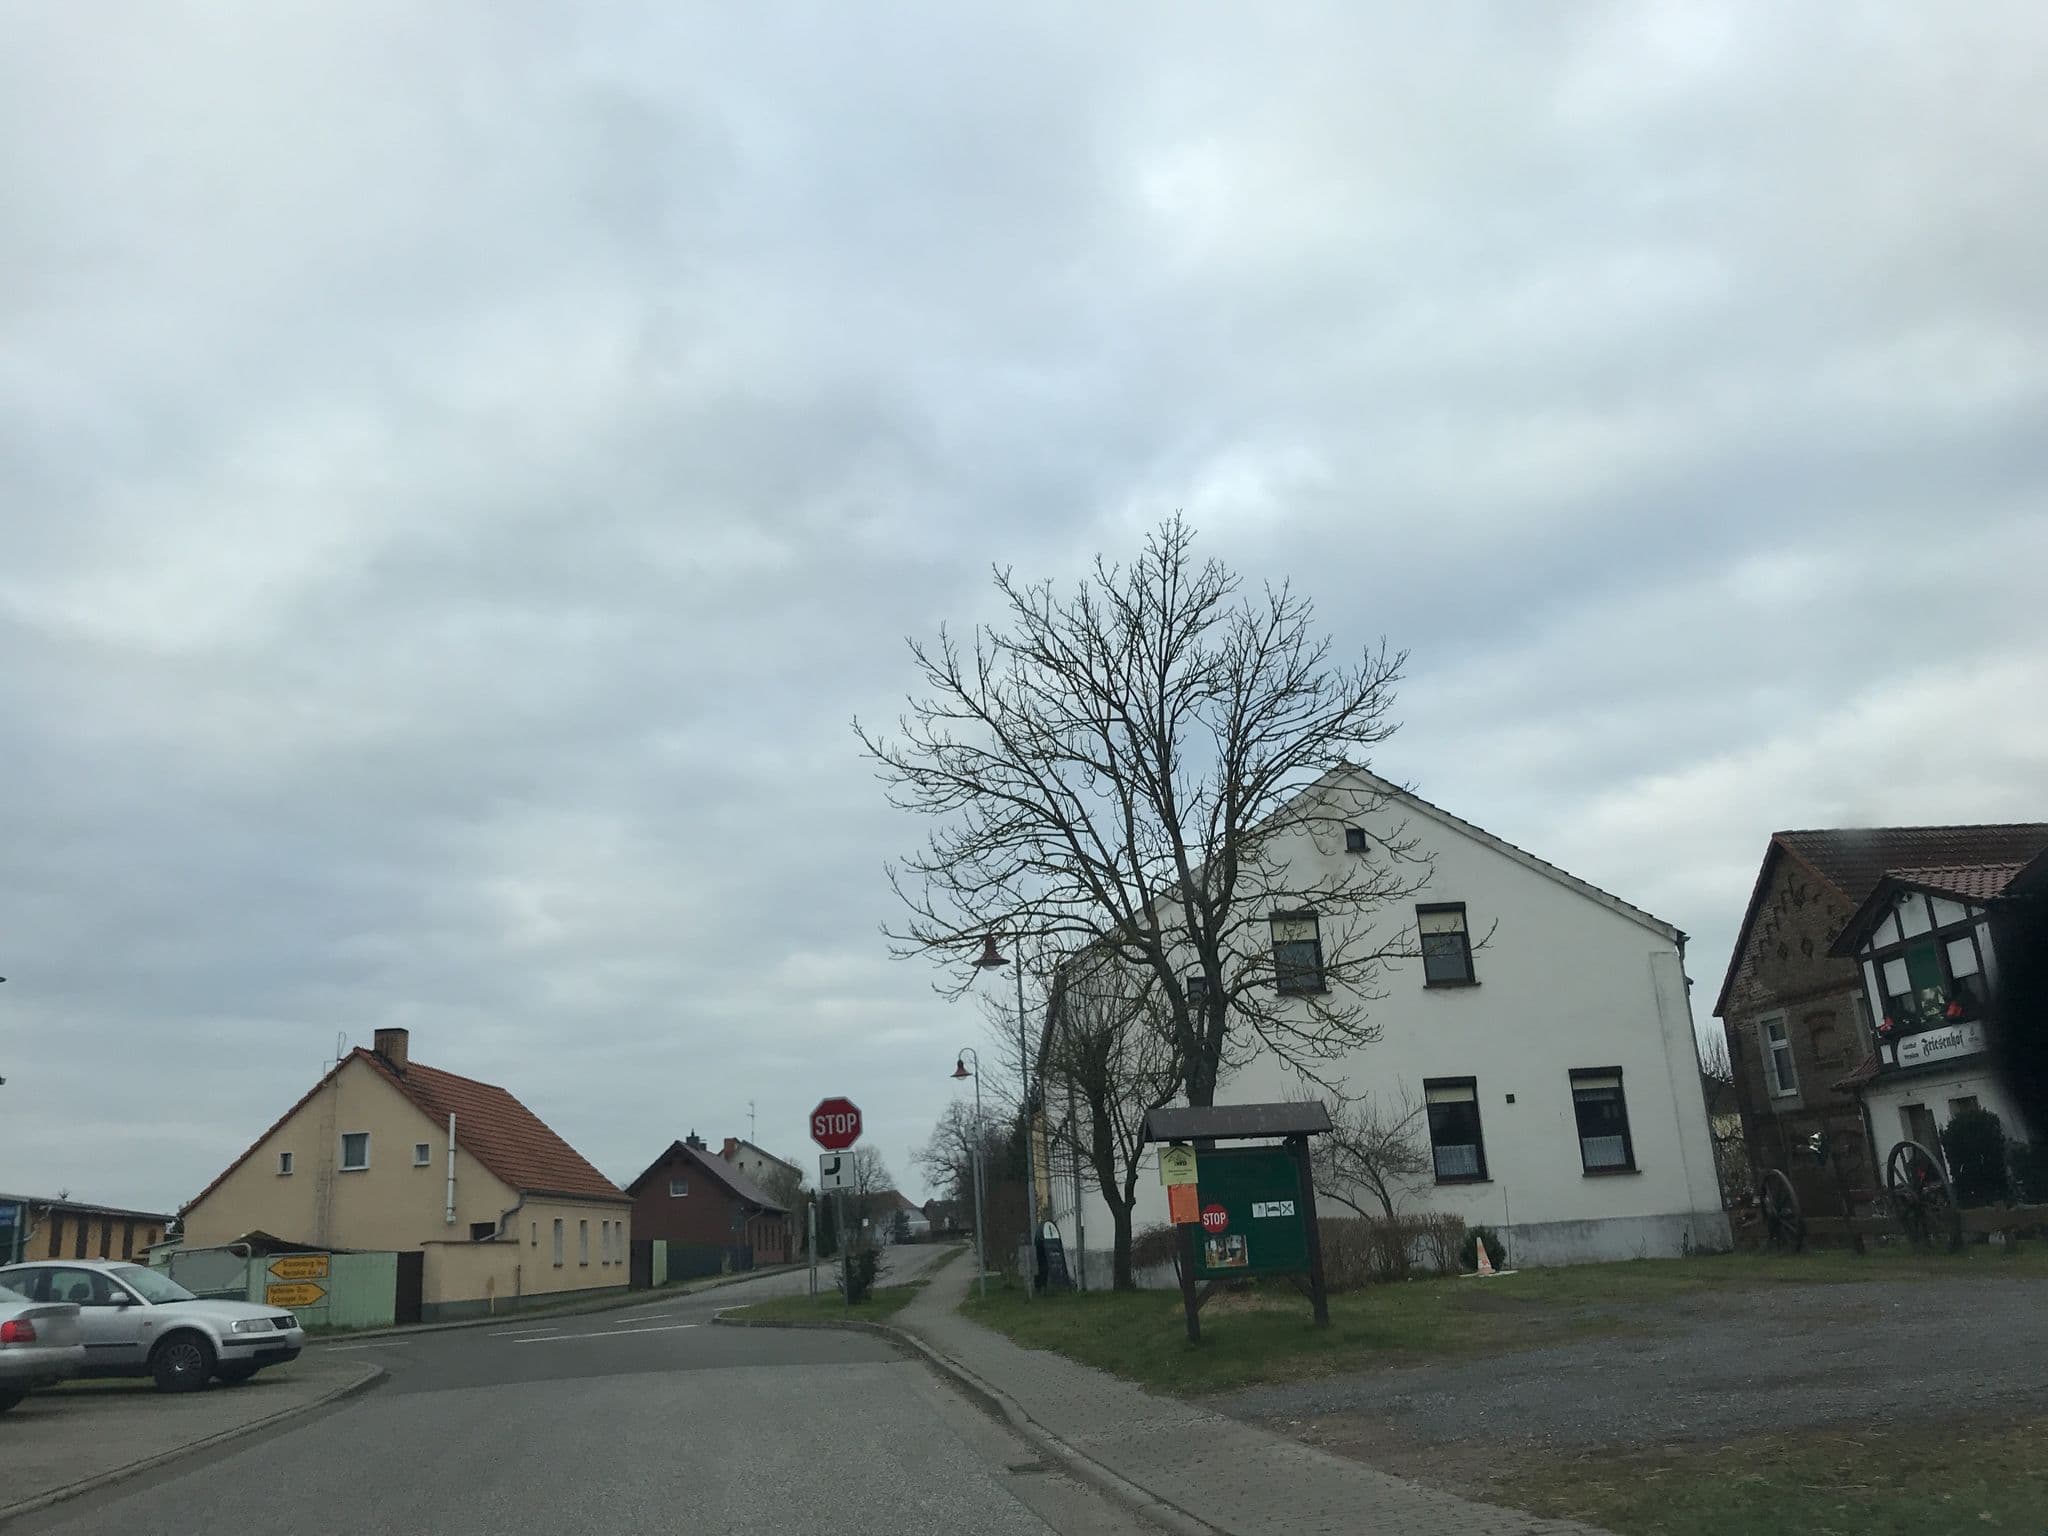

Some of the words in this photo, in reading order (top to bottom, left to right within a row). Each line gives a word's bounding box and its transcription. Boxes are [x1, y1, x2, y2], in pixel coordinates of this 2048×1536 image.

[1921, 1030, 1964, 1057] Friesenhof
[815, 1112, 857, 1136] STOP
[1202, 1212, 1226, 1226] STOP
